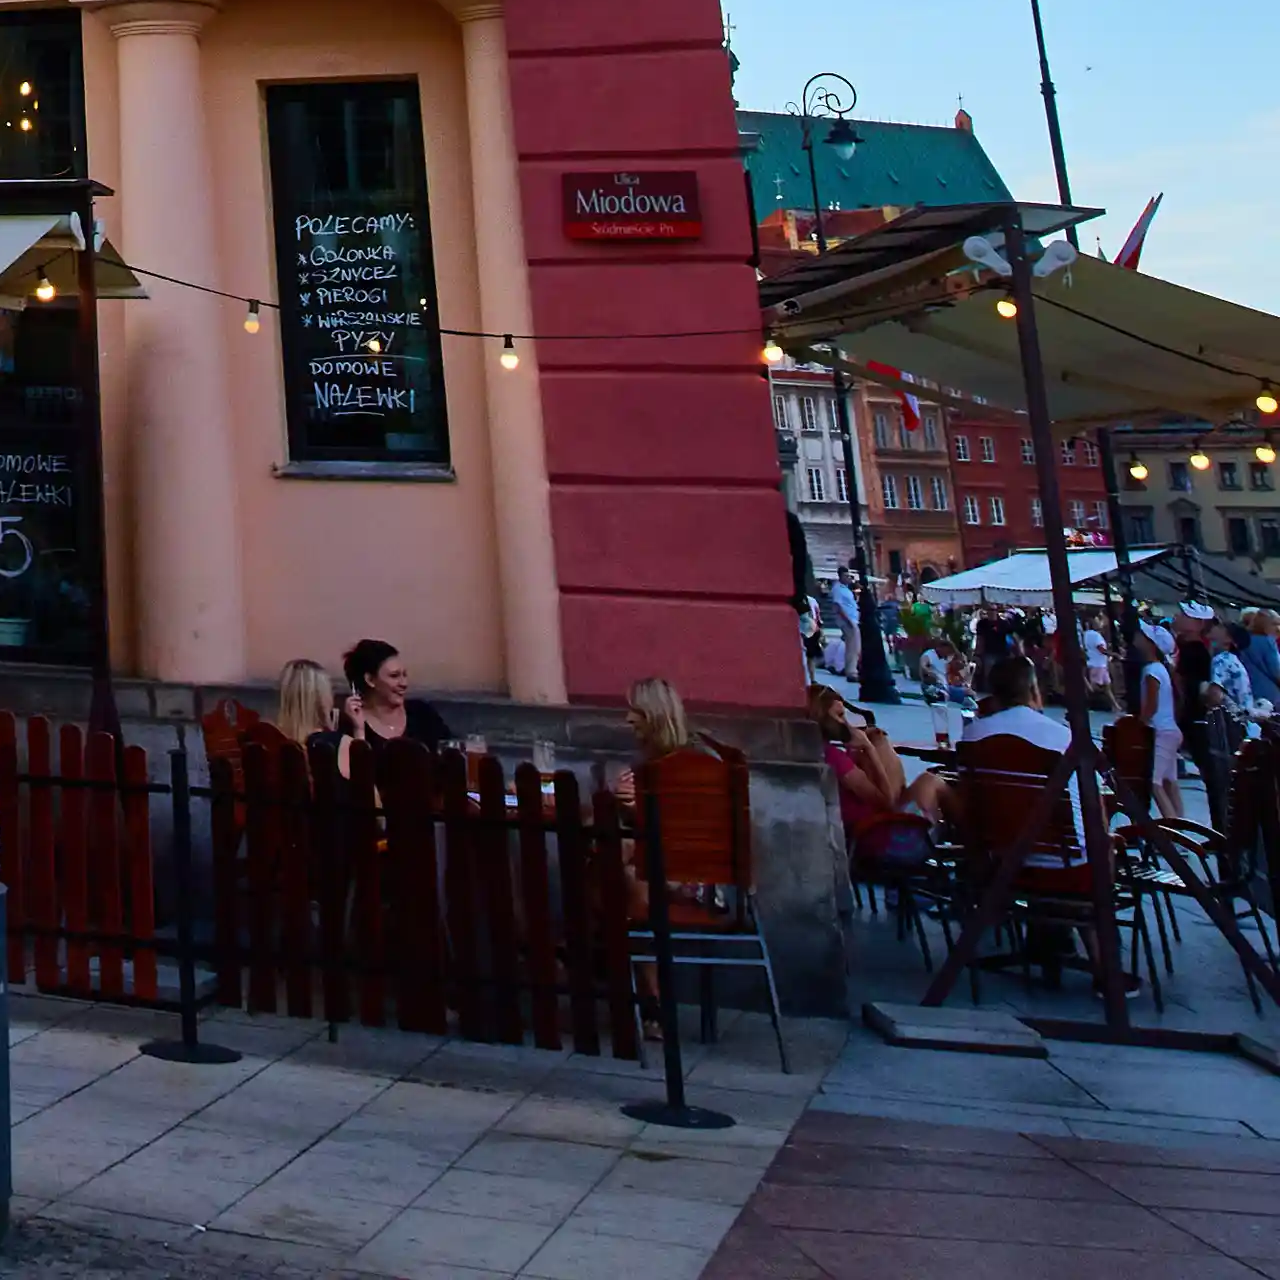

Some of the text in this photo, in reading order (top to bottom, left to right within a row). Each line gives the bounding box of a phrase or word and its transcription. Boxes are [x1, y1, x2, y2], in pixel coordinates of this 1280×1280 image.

[613, 173, 640, 185] Ulica
[576, 187, 687, 214] Miodowa
[295, 213, 415, 240] POLECAMY:
[310, 245, 396, 266] GOLONKA
[311, 266, 397, 283] SZNYCEL
[317, 287, 388, 307] PIEROGI
[331, 329, 395, 352] PYZY
[309, 361, 397, 377] DOMOWE
[314, 382, 415, 413] NALEWKI
